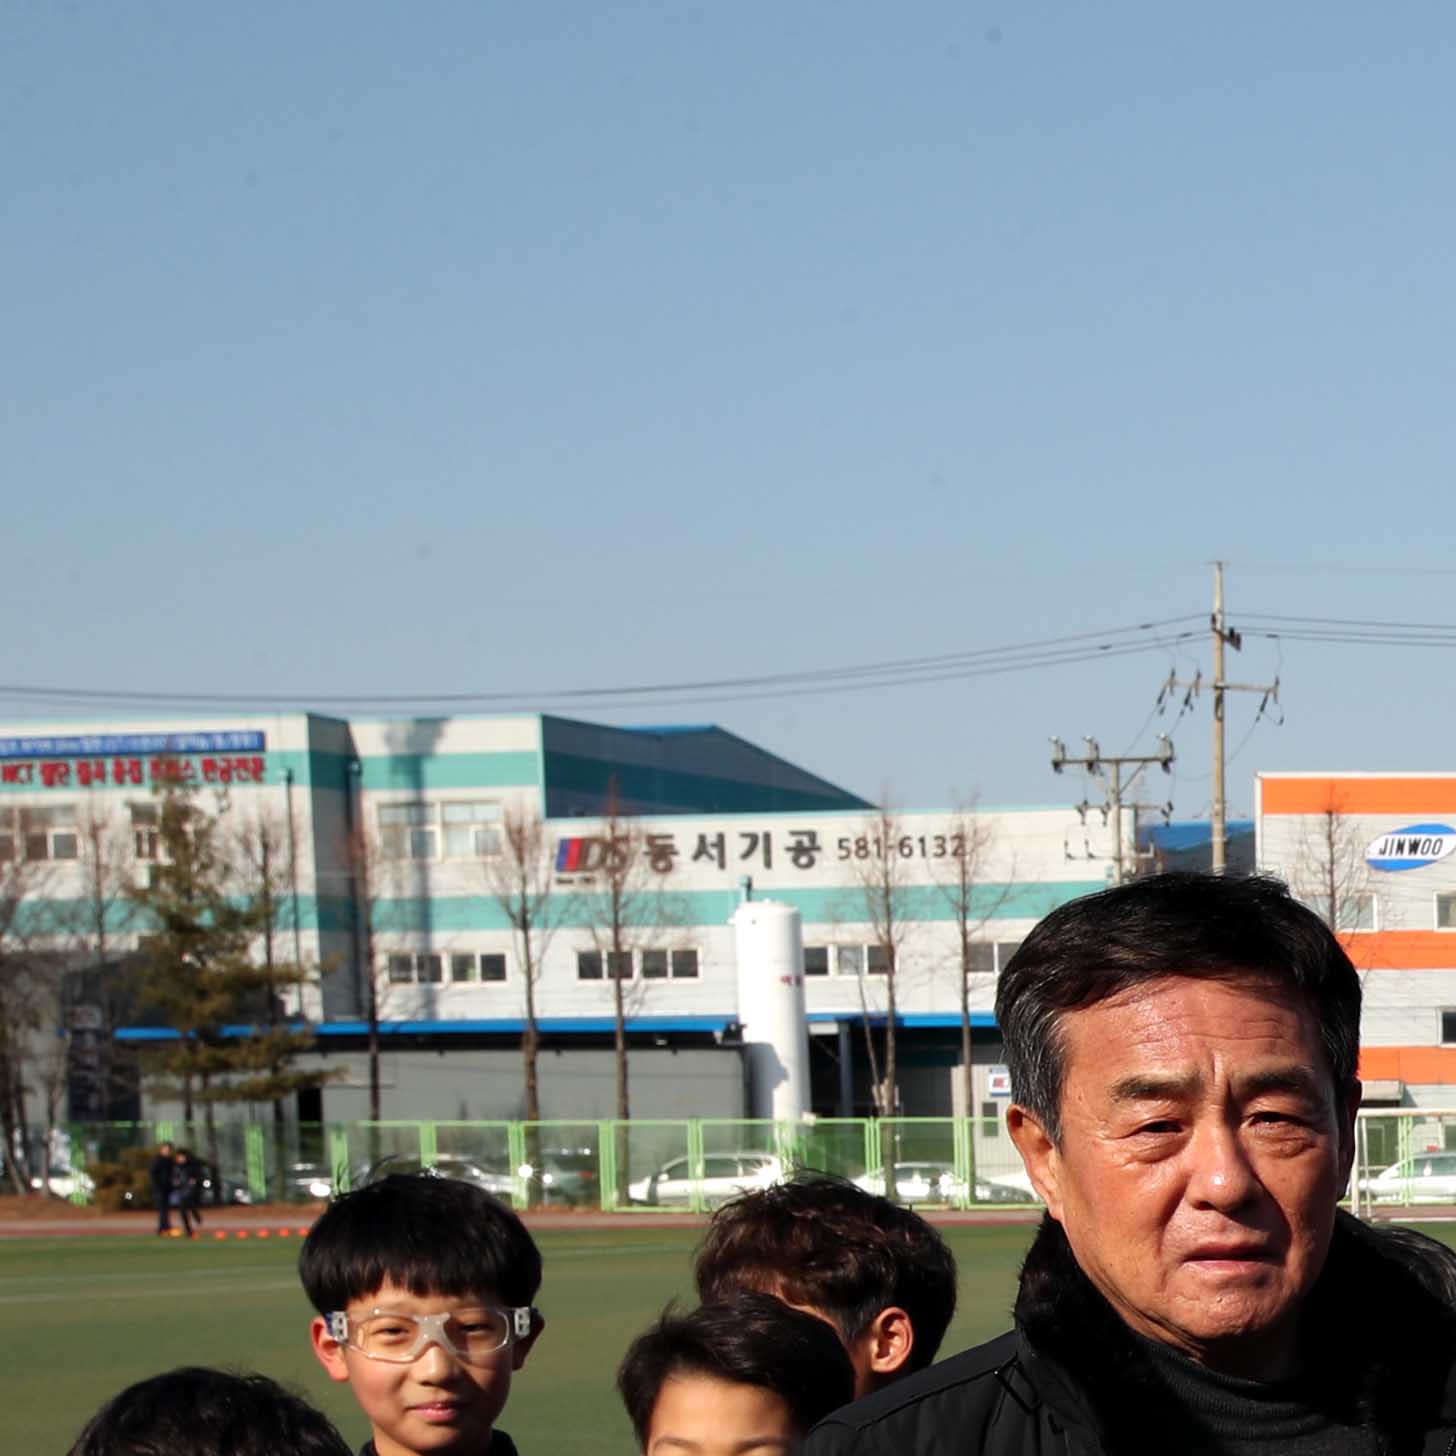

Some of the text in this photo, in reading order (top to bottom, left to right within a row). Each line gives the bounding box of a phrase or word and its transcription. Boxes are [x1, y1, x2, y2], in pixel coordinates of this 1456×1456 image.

[643, 831, 964, 873] 동서기공 581-6132
[1378, 837, 1444, 857] JINWOO
